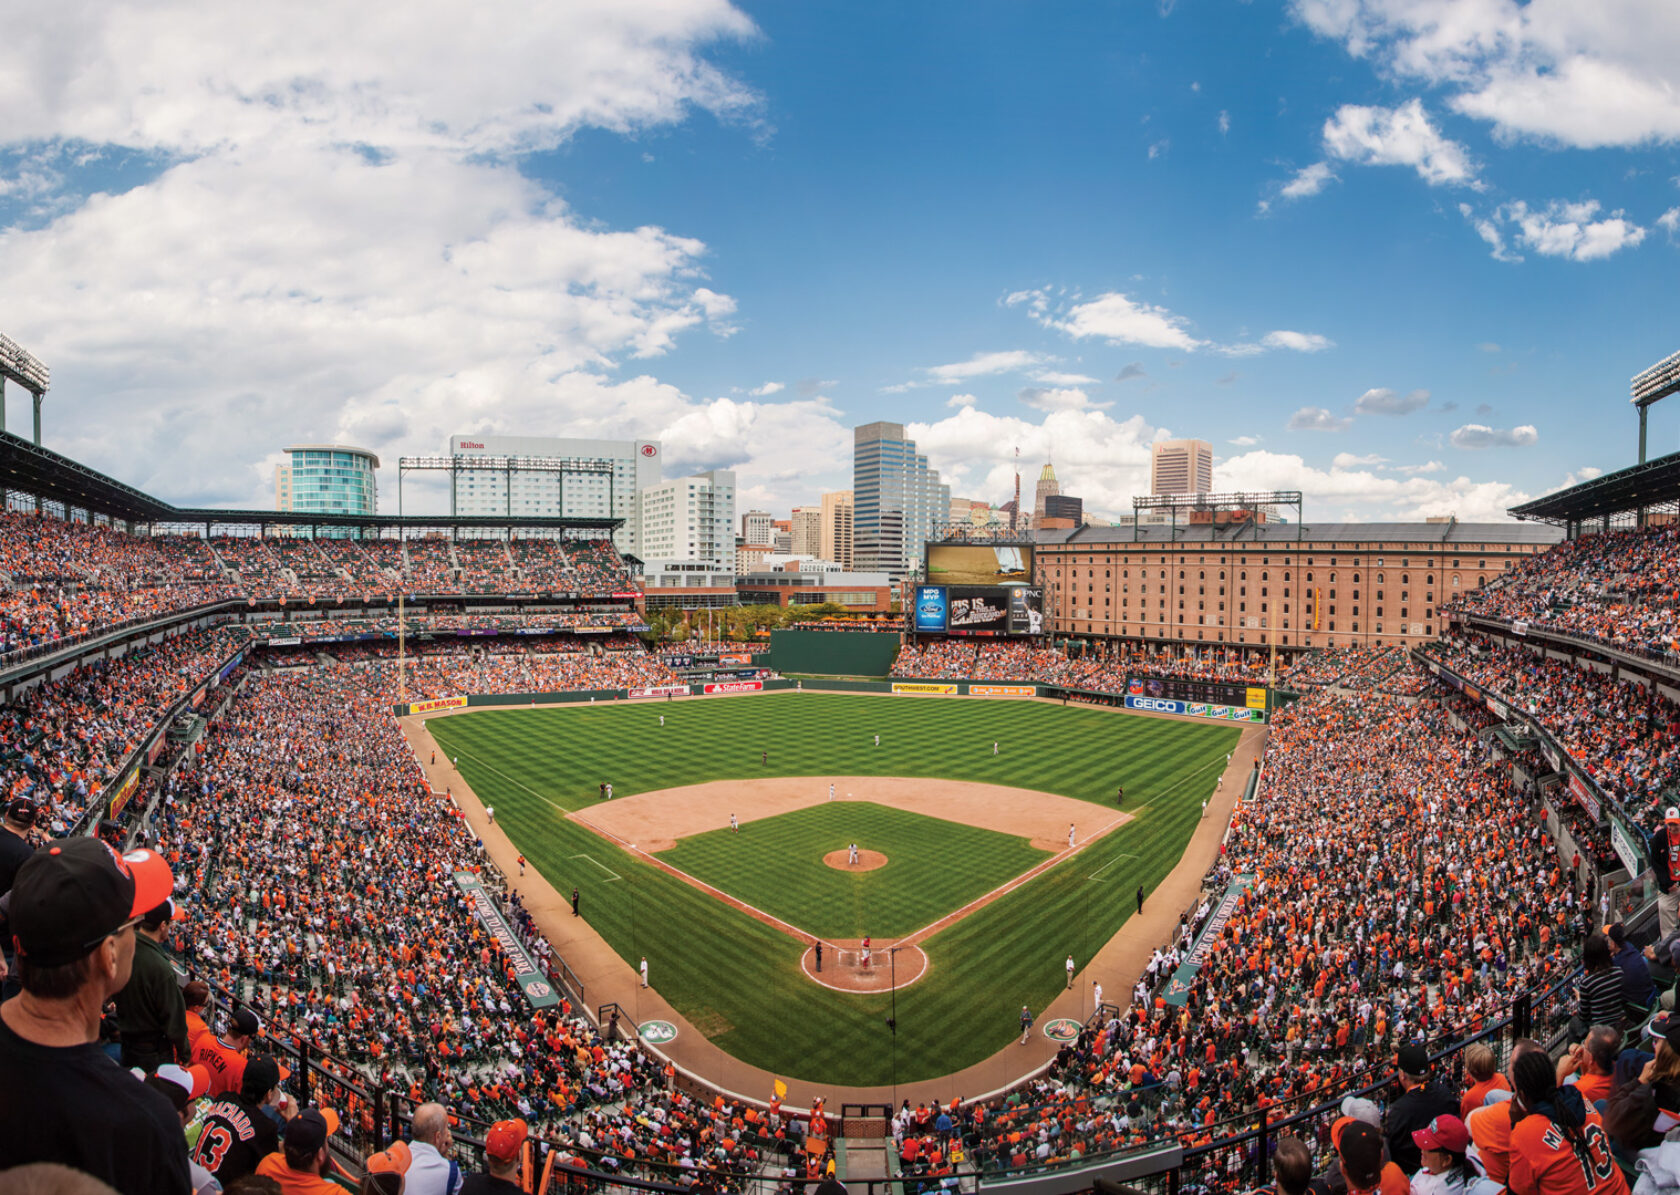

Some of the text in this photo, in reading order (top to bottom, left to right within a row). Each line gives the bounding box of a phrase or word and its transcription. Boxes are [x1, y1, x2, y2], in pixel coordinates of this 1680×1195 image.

[460, 441, 485, 449] Hilton
[1024, 590, 1042, 598] PNC
[434, 700, 462, 708] MASON
[1133, 698, 1176, 712] GEICO
[1190, 704, 1251, 720] Gulf Gulf Gulf
[511, 952, 533, 974] PARK
[200, 1048, 227, 1073] RIPKEN
[193, 1121, 232, 1173] 13
[1574, 1122, 1613, 1191] 13
